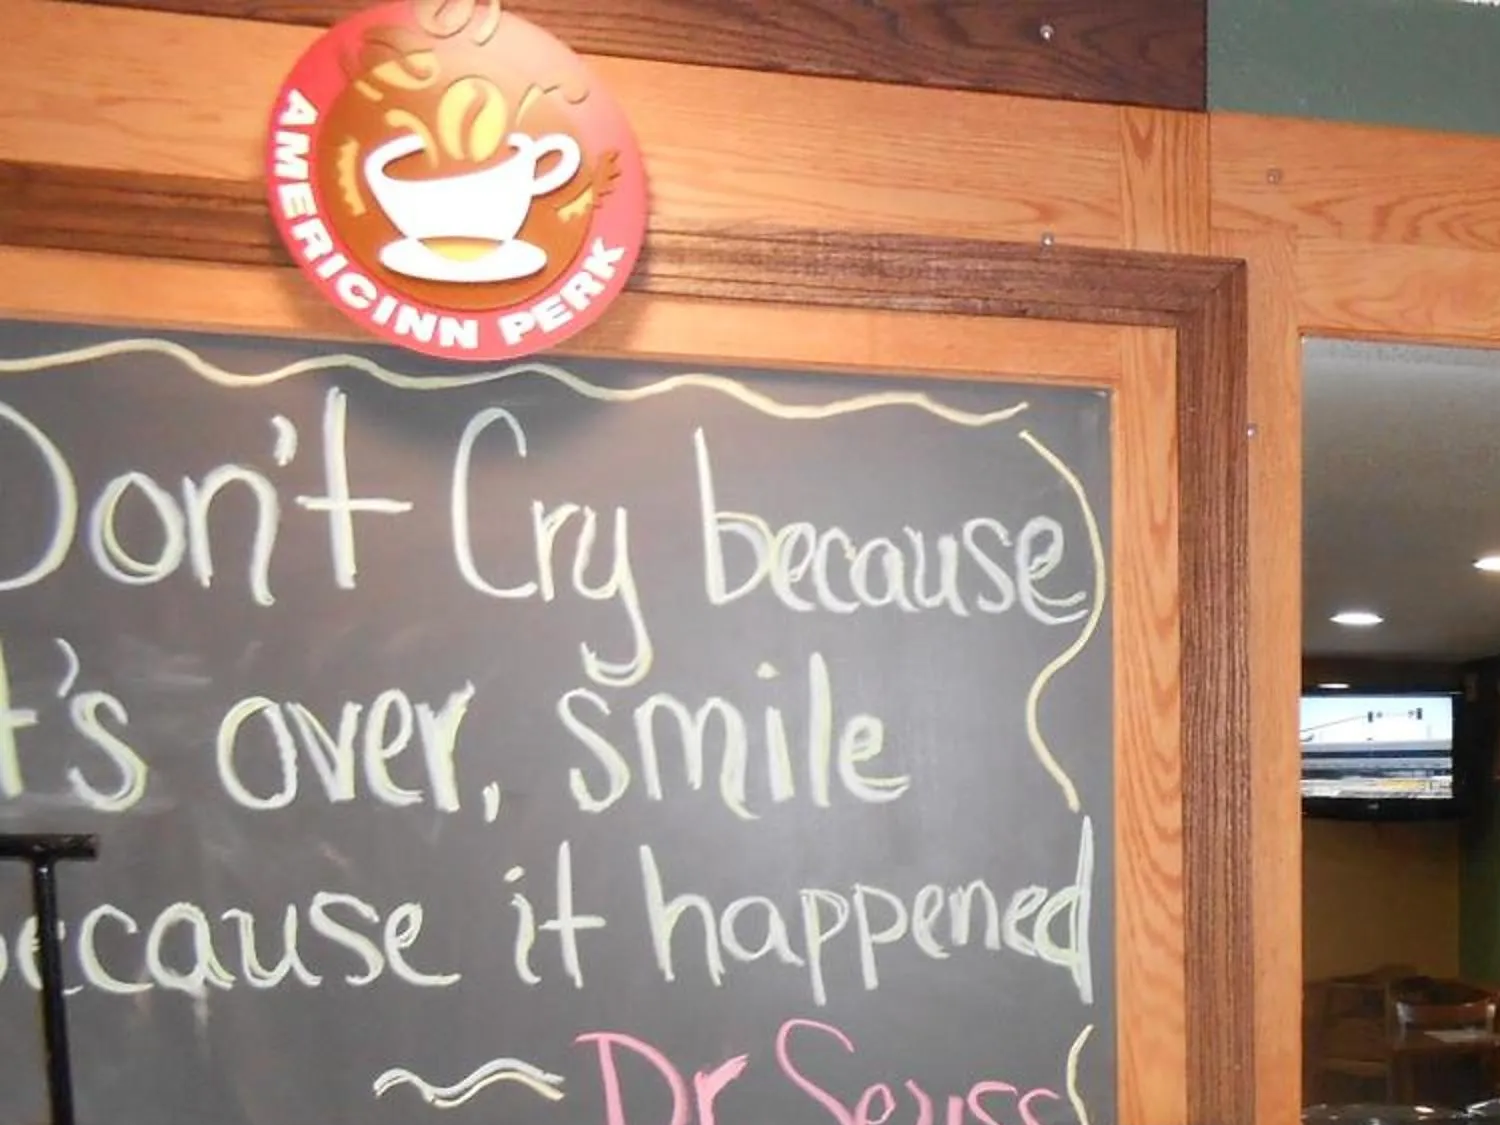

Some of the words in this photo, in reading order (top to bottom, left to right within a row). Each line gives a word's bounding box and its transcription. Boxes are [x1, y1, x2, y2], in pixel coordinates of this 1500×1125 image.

[272, 88, 480, 350] AMERICINN
[499, 237, 626, 347] PERK
[451, 407, 654, 686] Cry
[693, 426, 1090, 625] because
[0, 635, 148, 812] t's
[216, 680, 500, 822] over,
[556, 652, 911, 820] smile
[0, 890, 461, 995] ecause
[503, 840, 606, 989] it
[639, 814, 1094, 1007] happened
